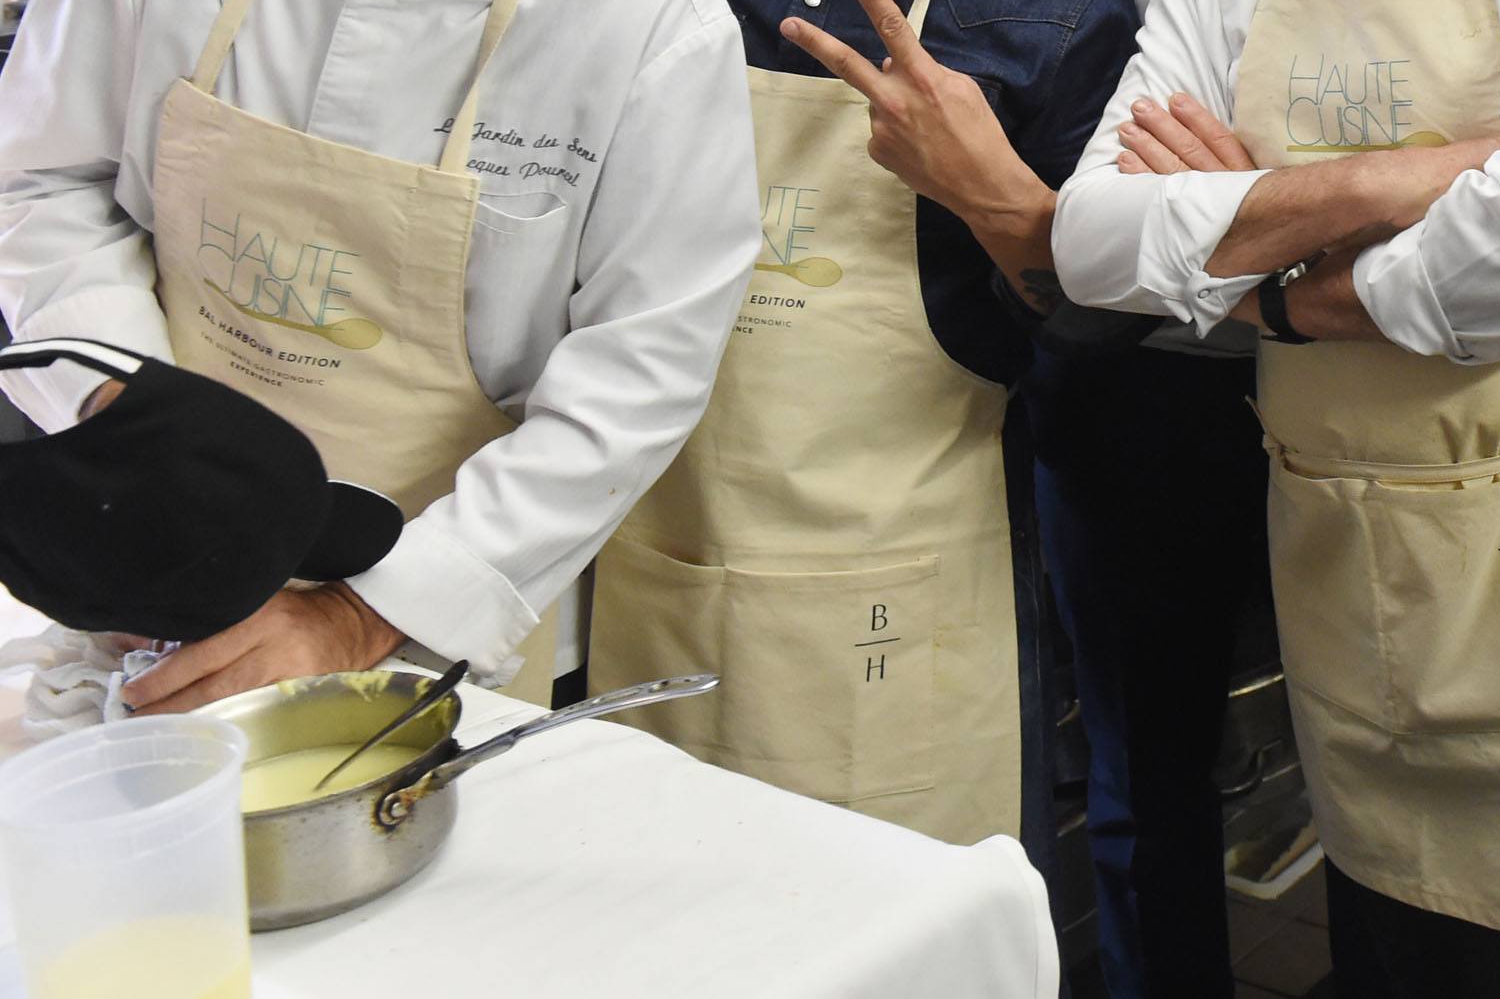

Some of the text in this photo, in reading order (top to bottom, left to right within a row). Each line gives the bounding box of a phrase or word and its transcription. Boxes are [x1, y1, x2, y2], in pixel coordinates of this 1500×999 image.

[1289, 54, 1412, 105] HAUTE
[1287, 97, 1412, 146] CUISINE
[472, 122, 525, 147] Jardin
[533, 134, 560, 149] des
[567, 138, 597, 162] Sens
[466, 158, 510, 176] cques
[200, 197, 361, 296] HAUTE
[198, 243, 352, 331] CUISINE
[750, 294, 806, 309] EDITION
[737, 315, 791, 327] STRONOMIC
[198, 306, 341, 368] BAL HARBOUR EDITION
[230, 362, 283, 387] EXPERIENCE
[254, 362, 325, 386] GASTRONOMIC
[872, 604, 888, 631] B
[866, 654, 885, 682] H
